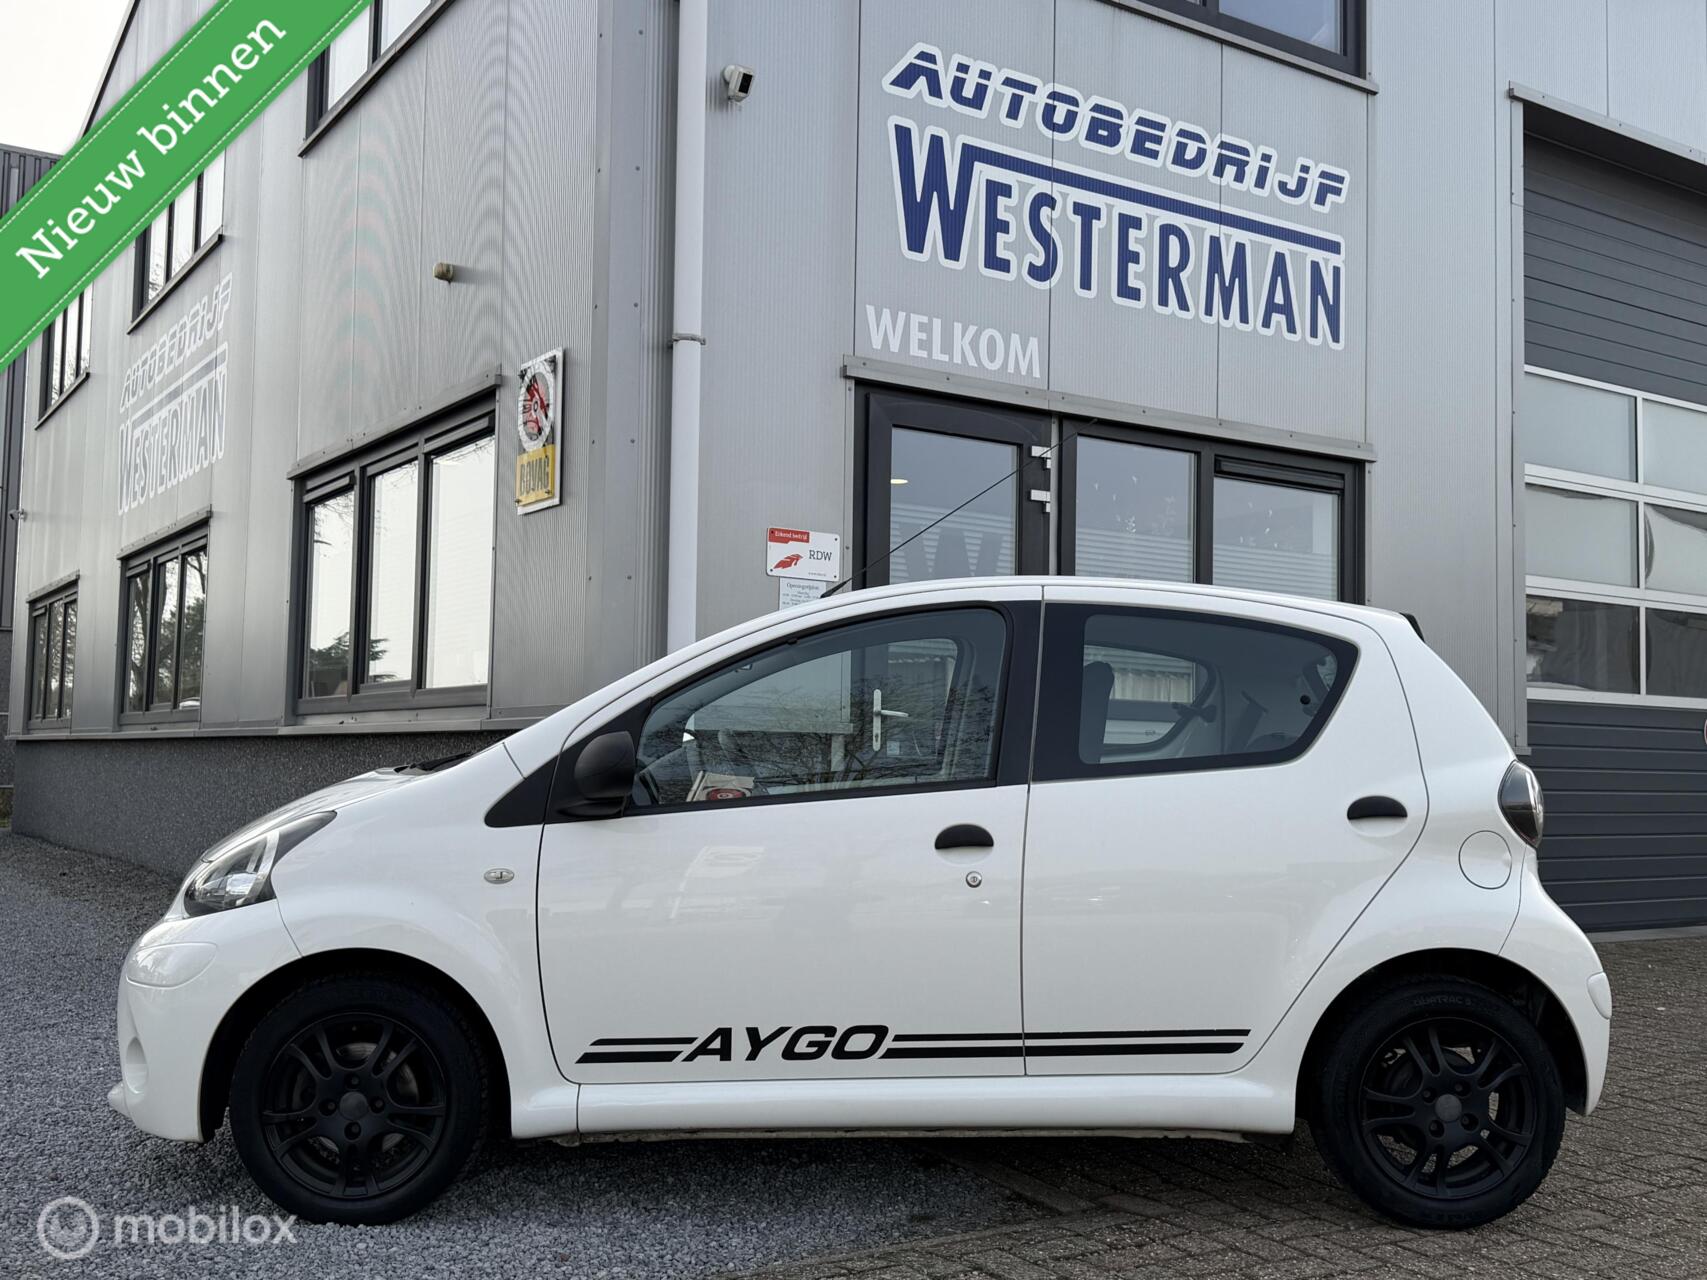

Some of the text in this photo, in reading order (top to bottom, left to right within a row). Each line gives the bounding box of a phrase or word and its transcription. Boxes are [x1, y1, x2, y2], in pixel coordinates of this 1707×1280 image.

[886, 46, 1348, 210] AUTOBEDRIJF
[892, 121, 1343, 347] WESTERMAN
[119, 272, 233, 414] AUTOBEDRIJF
[865, 304, 1042, 378] WELKOM
[117, 342, 229, 517] WESTERMAN
[519, 457, 550, 496] BOVAG
[809, 550, 832, 561] RDW
[681, 1025, 889, 1062] AYGO
